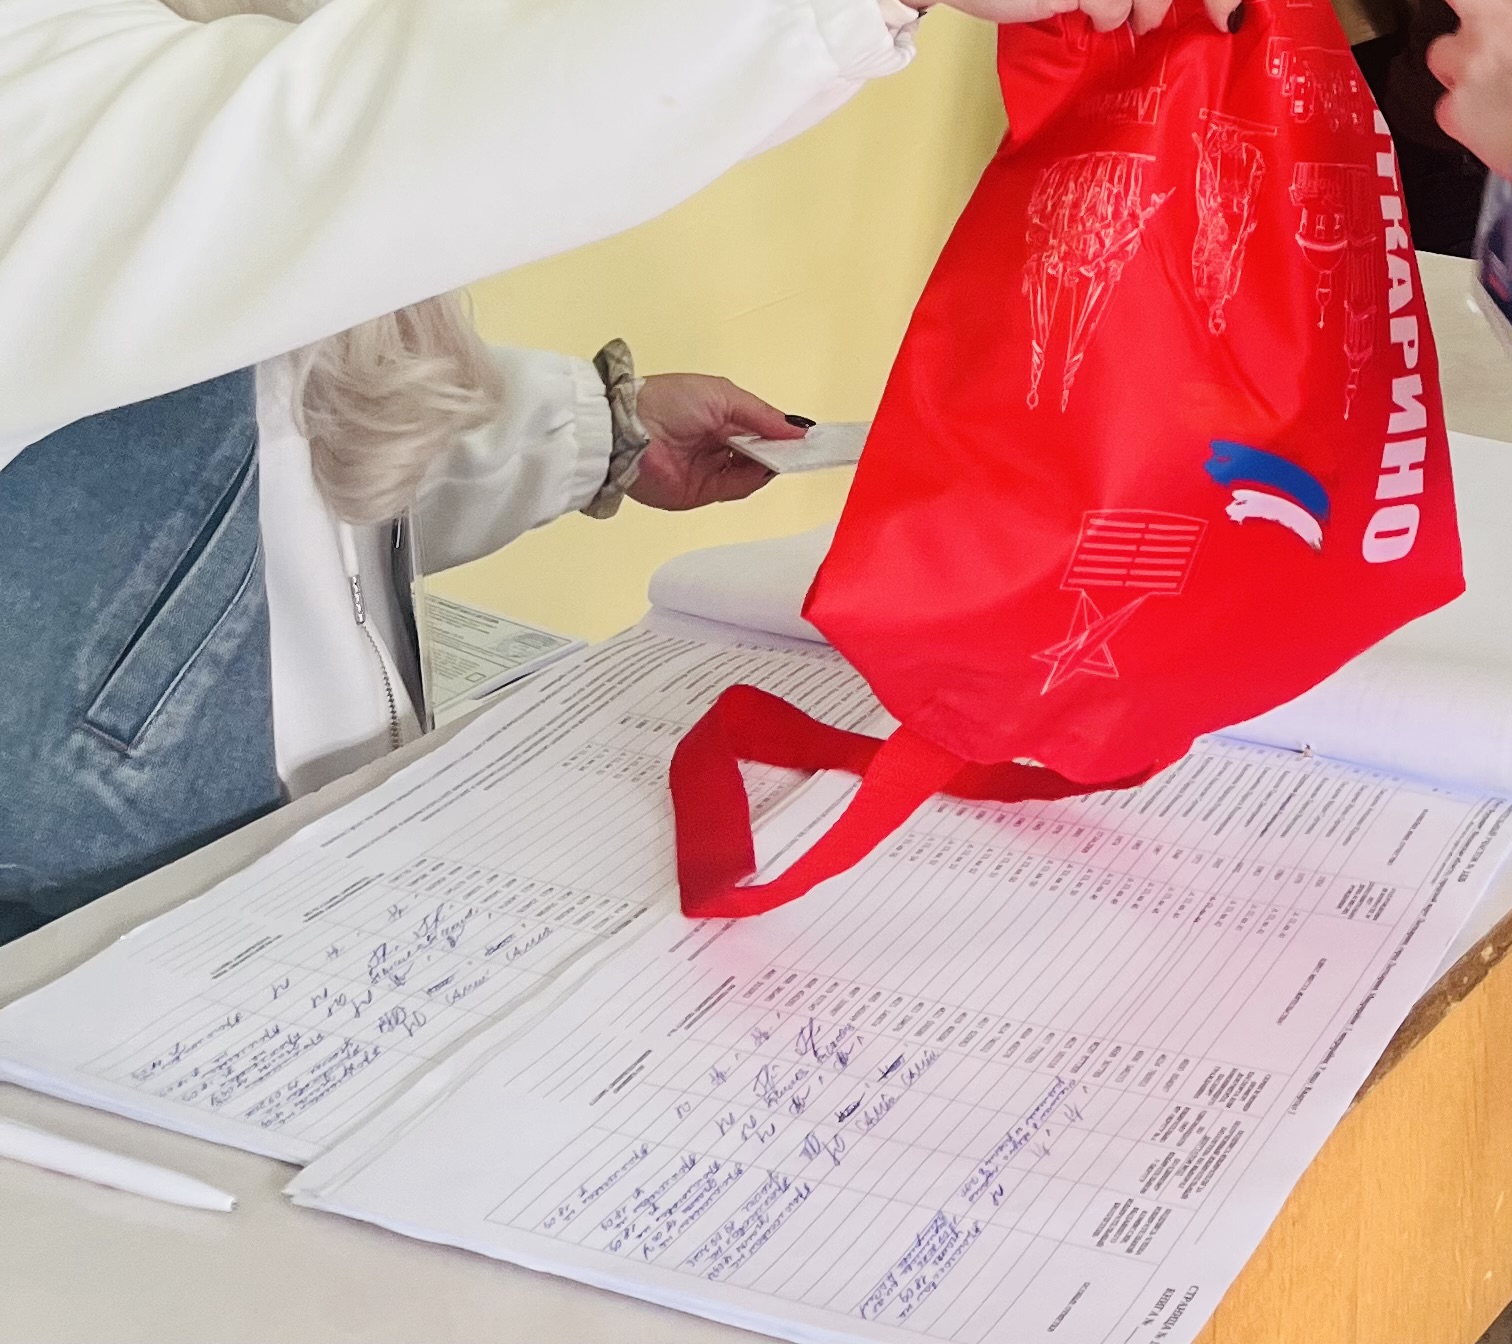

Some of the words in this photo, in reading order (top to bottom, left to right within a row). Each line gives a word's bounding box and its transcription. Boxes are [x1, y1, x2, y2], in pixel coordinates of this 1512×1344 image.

[1361, 110, 1428, 564] ТКАРИНО
[1148, 1287, 1176, 1317] КНИГА
[1161, 1285, 1200, 1330] СТРАНИЦА
